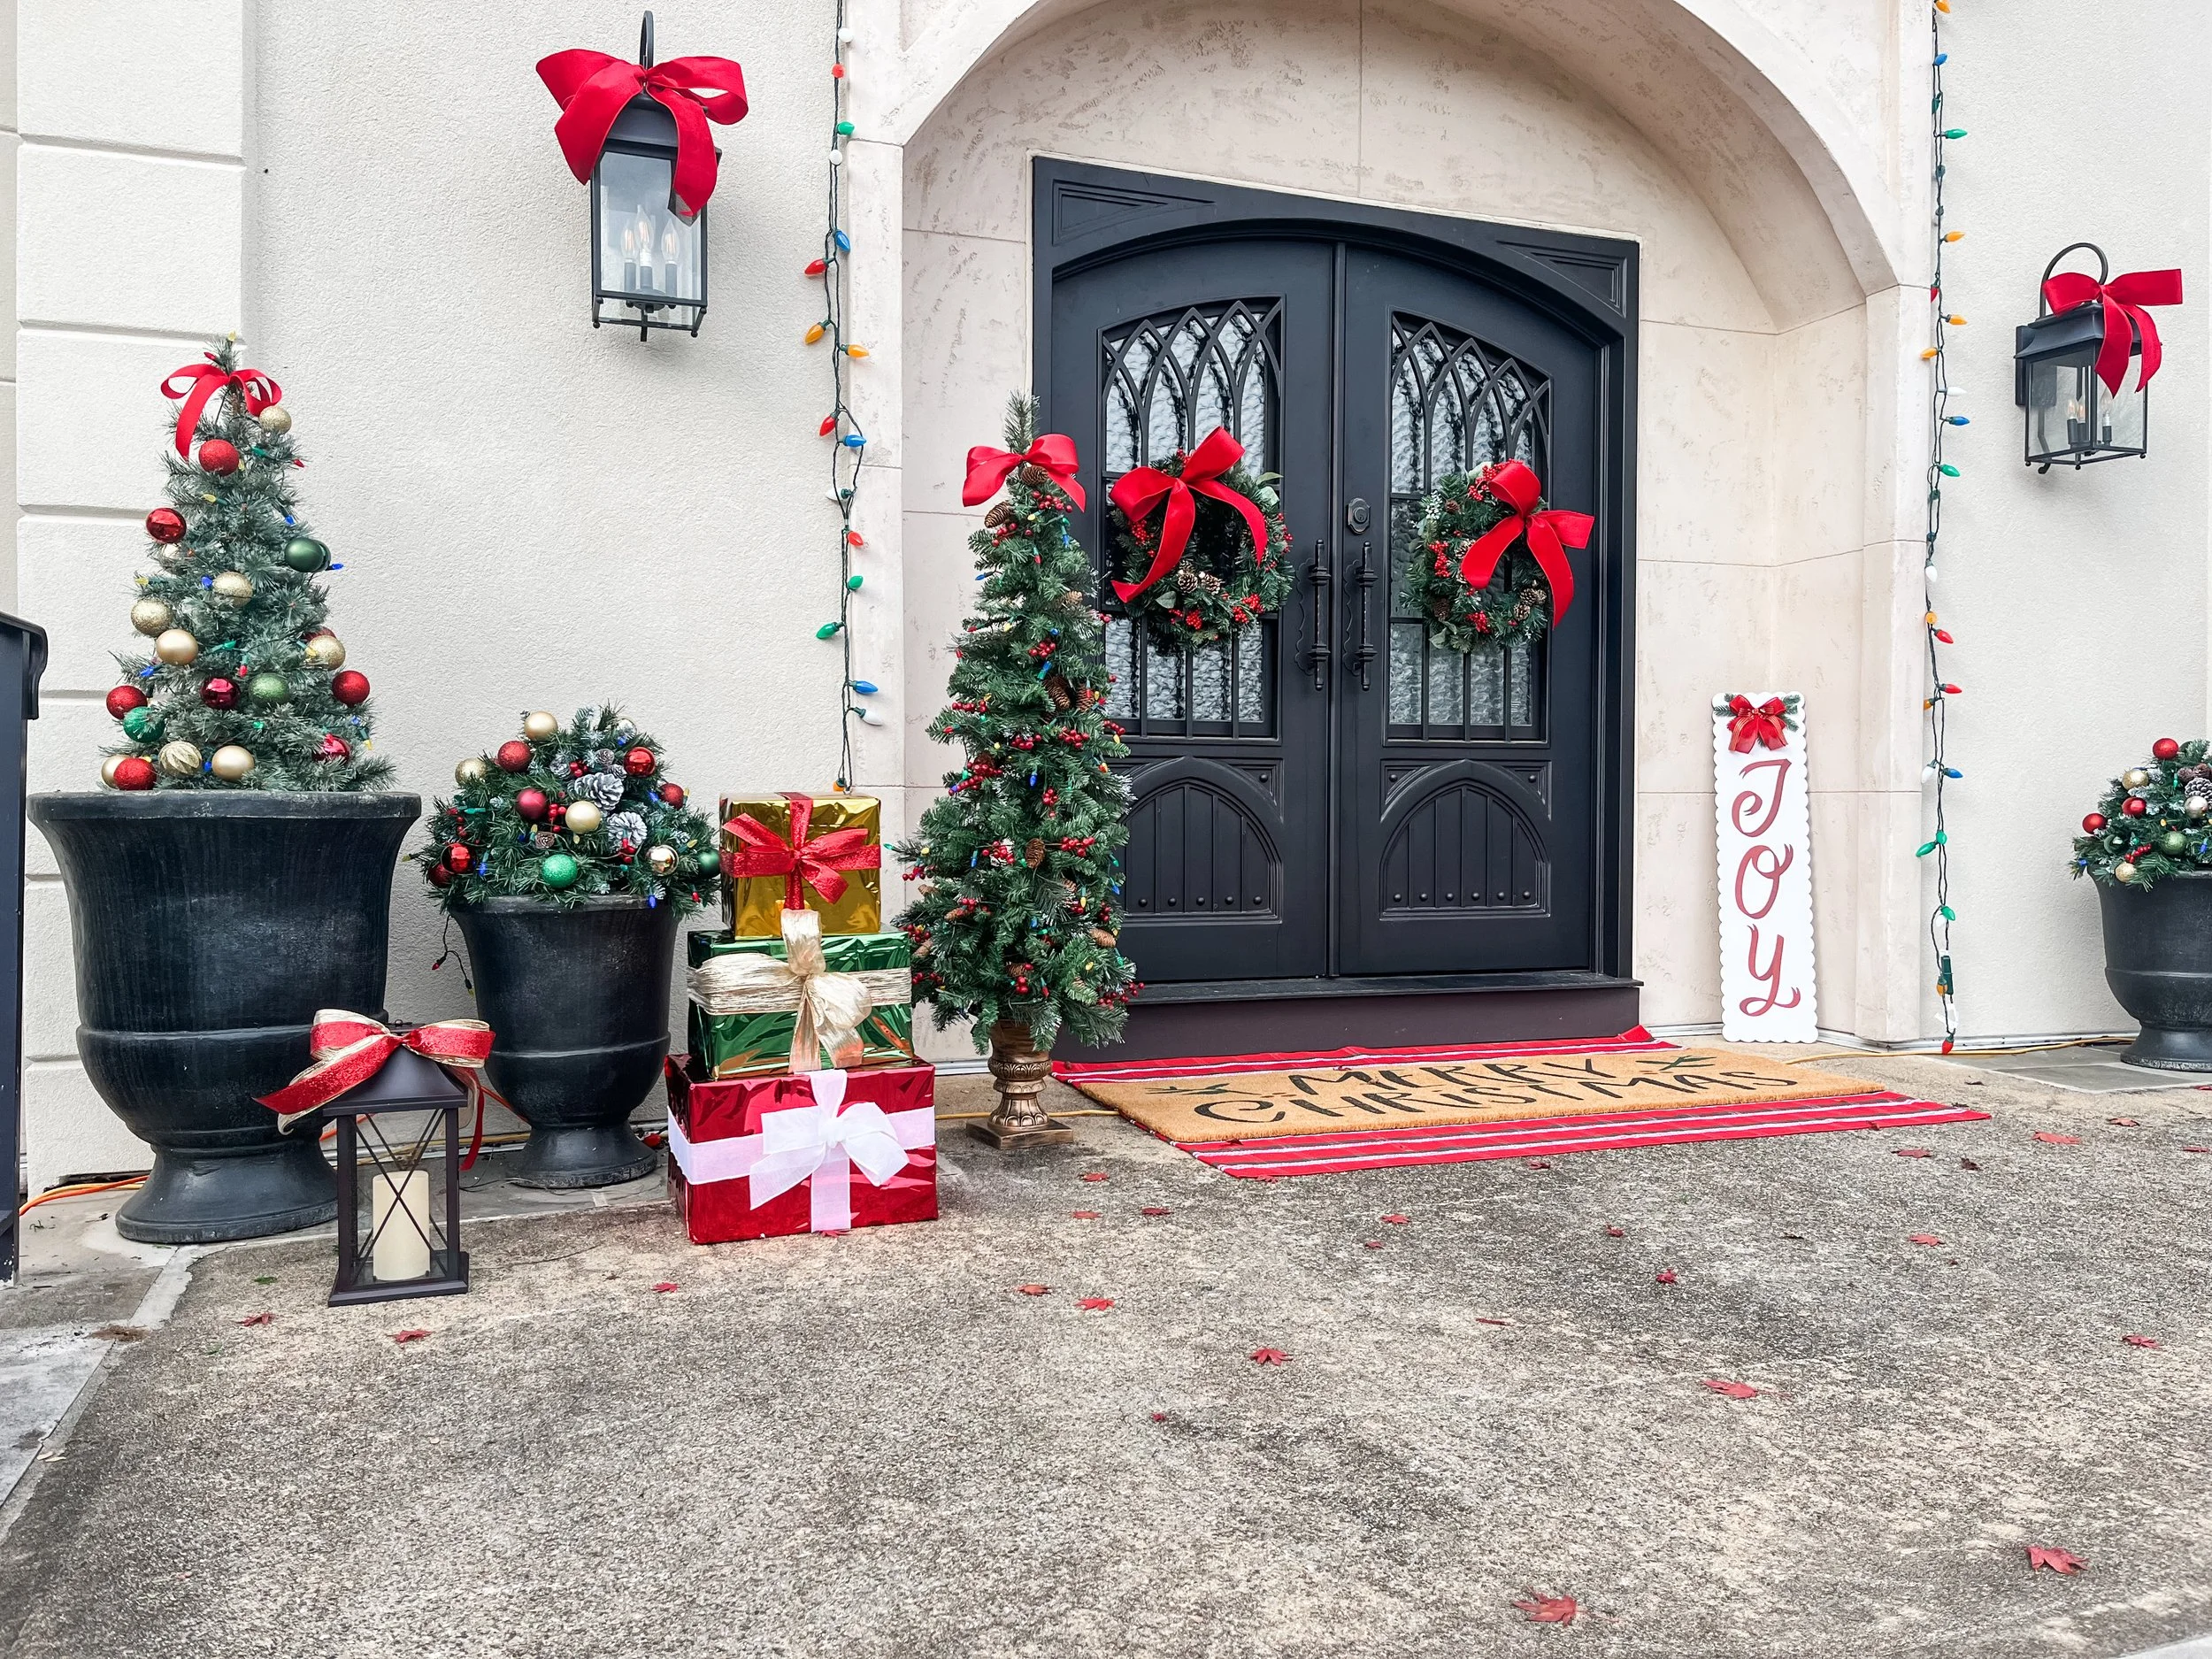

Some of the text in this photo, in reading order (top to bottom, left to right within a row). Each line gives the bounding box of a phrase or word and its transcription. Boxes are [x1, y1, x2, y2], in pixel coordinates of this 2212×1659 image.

[1732, 758, 1801, 1017] JOY
[1194, 1071, 1797, 1123] CHRISTMAS
[1288, 1058, 1617, 1095] MERRY
